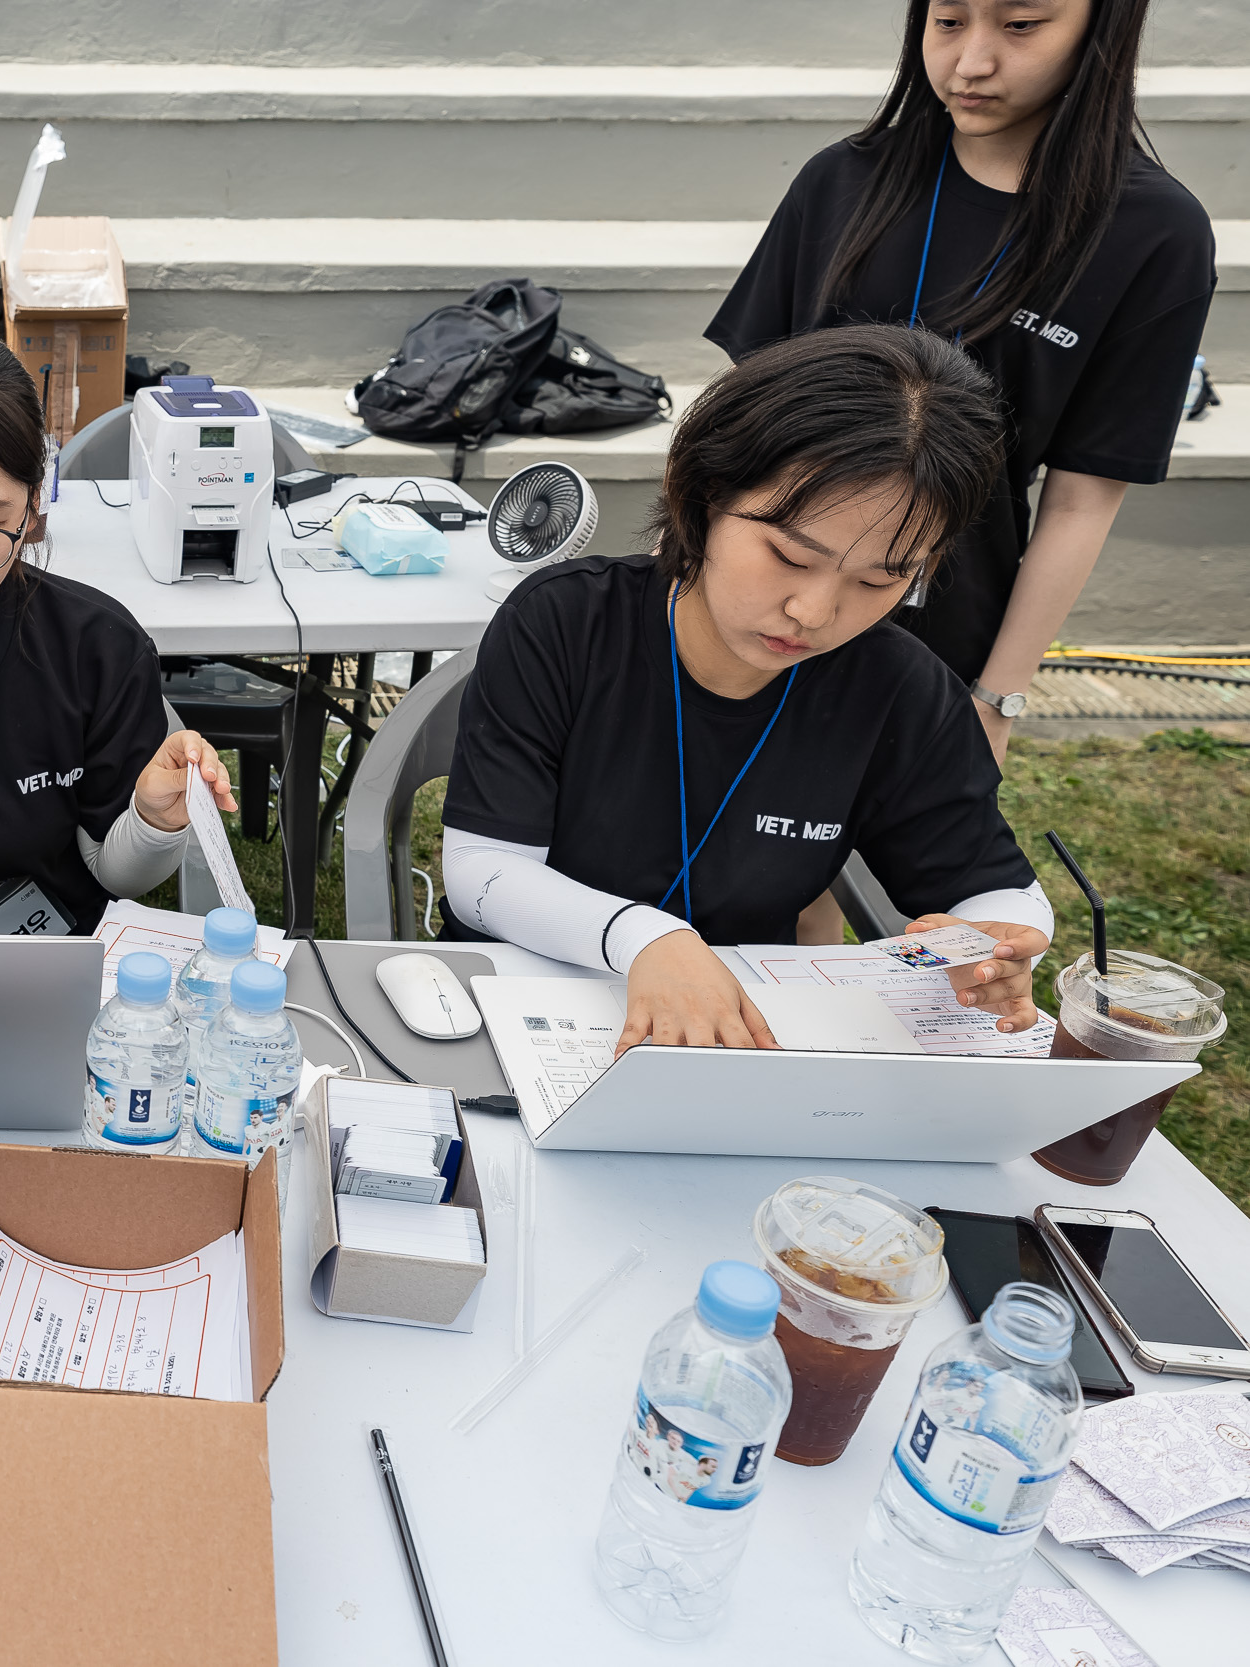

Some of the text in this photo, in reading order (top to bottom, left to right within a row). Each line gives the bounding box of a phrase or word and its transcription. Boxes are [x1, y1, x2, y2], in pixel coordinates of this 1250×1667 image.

[1010, 308, 1079, 348] ET. MED
[198, 476, 234, 484] POINTMAN
[16, 772, 52, 795] VET.
[756, 814, 842, 841] VET. MED
[811, 1110, 864, 1118] gram
[3, 1340, 13, 1352] 22
[31, 1366, 40, 1382] 려동물
[953, 1464, 980, 1506] 마신다
